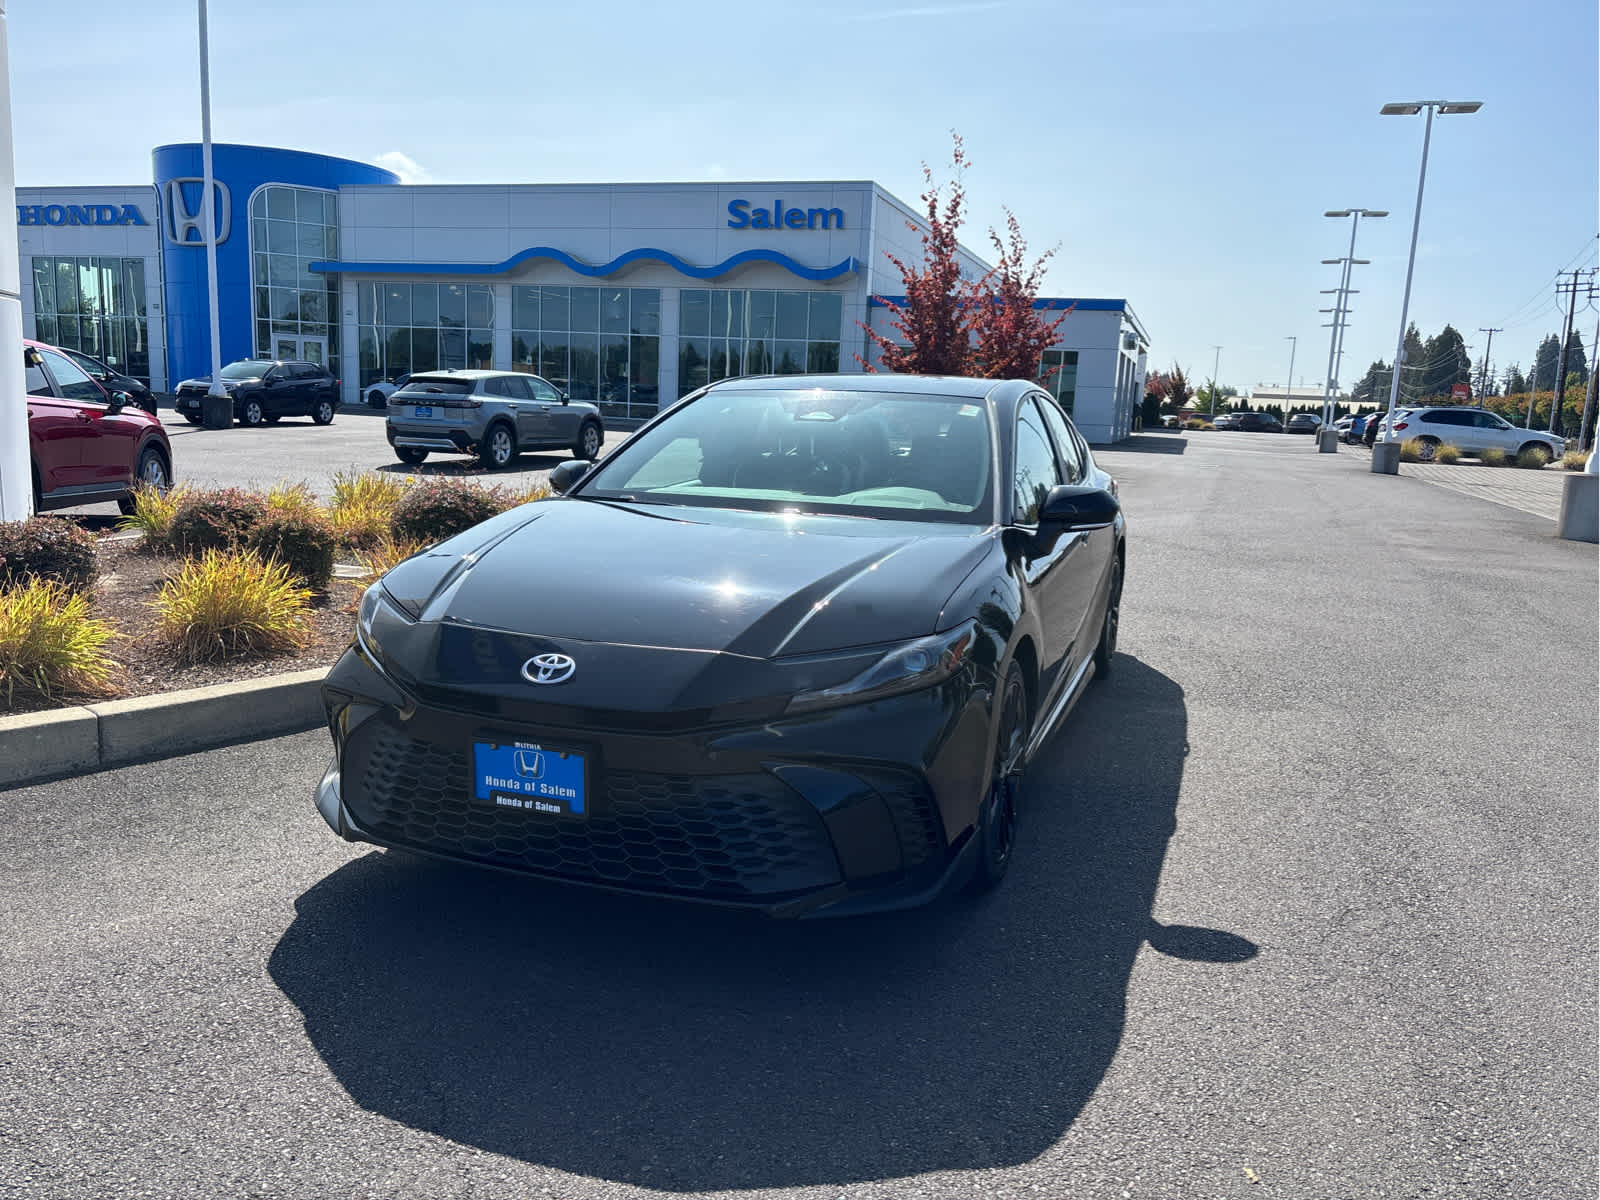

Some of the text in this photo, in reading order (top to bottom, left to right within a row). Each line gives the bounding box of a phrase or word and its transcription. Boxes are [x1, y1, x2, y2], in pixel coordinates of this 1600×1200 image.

[16, 204, 149, 226] HONDA
[727, 199, 844, 230] Salem
[485, 775, 576, 798] Honda of Salem
[496, 795, 561, 813] Honda of Salem
